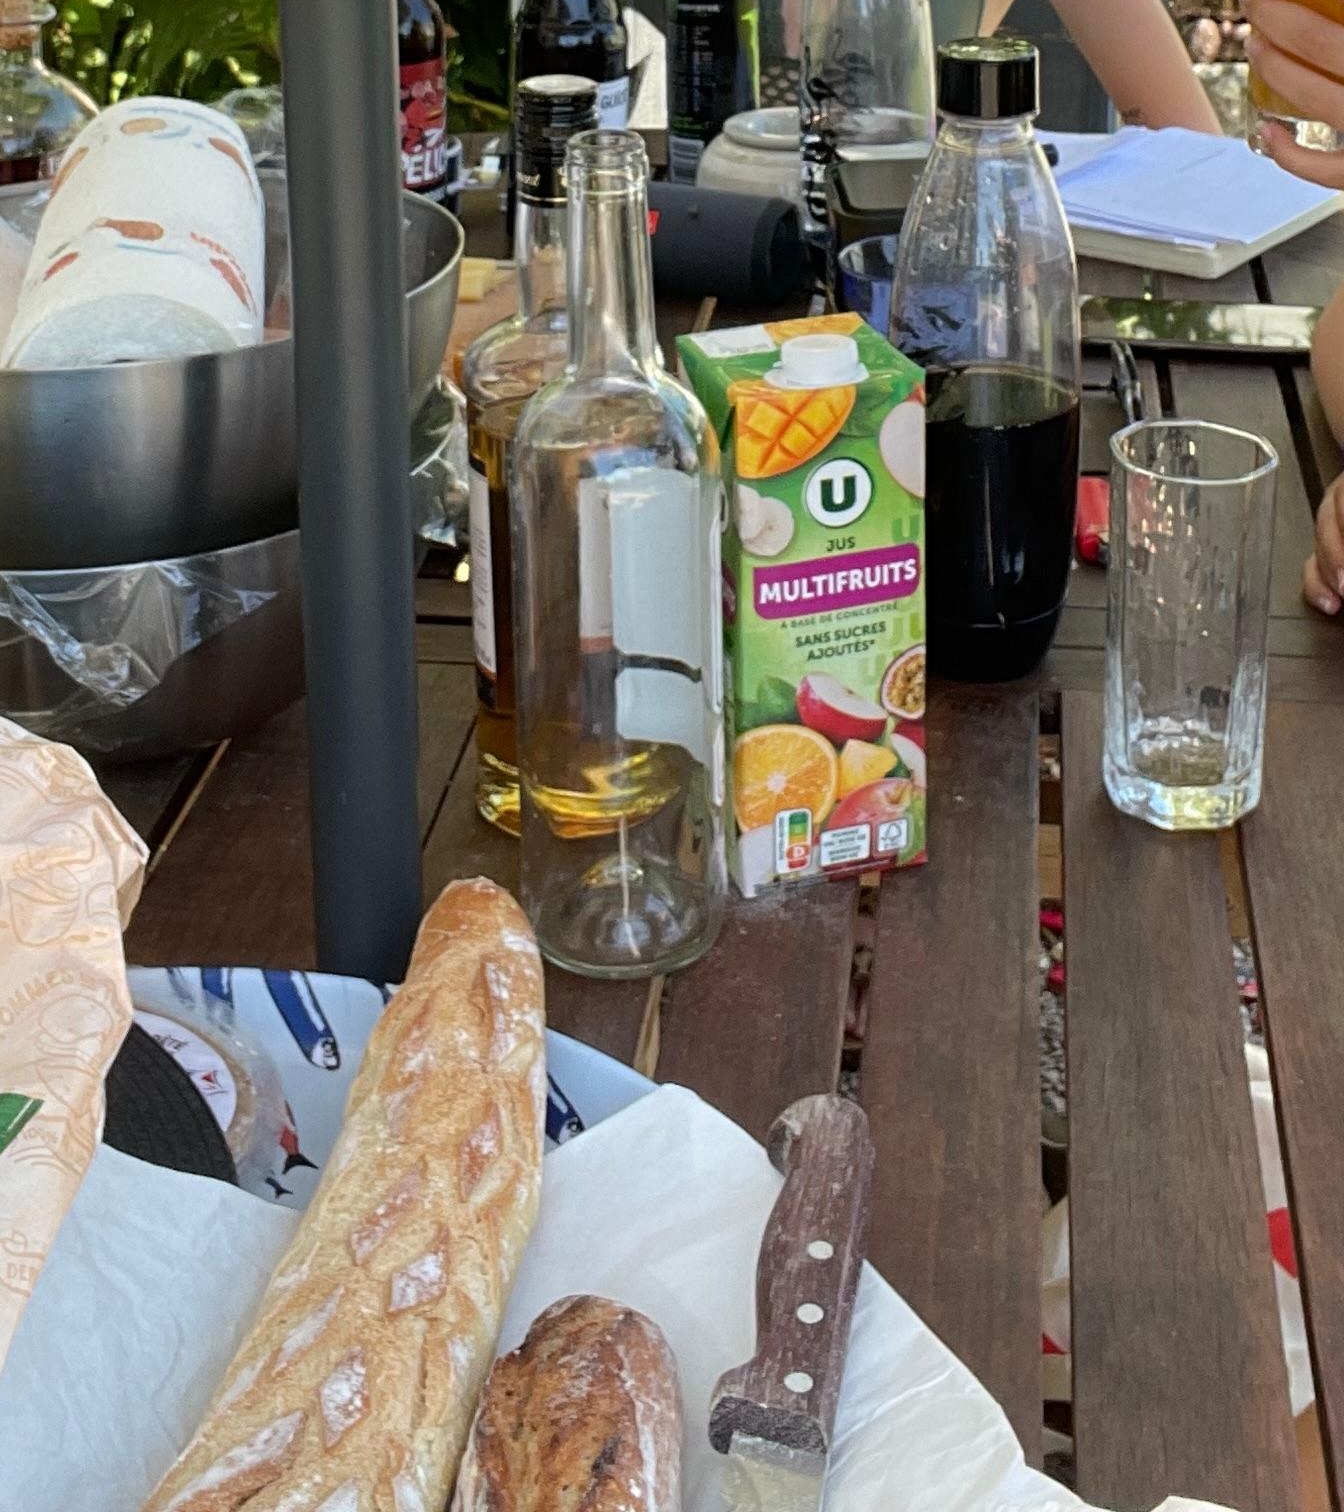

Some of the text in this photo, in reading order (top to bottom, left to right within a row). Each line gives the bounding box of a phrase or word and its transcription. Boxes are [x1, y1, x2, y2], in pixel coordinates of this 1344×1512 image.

[820, 475, 857, 516] U
[826, 536, 856, 552] JUS
[759, 558, 917, 605] MULTIFRUITS
[795, 631, 832, 648] SANS
[833, 621, 887, 642] SUCRES
